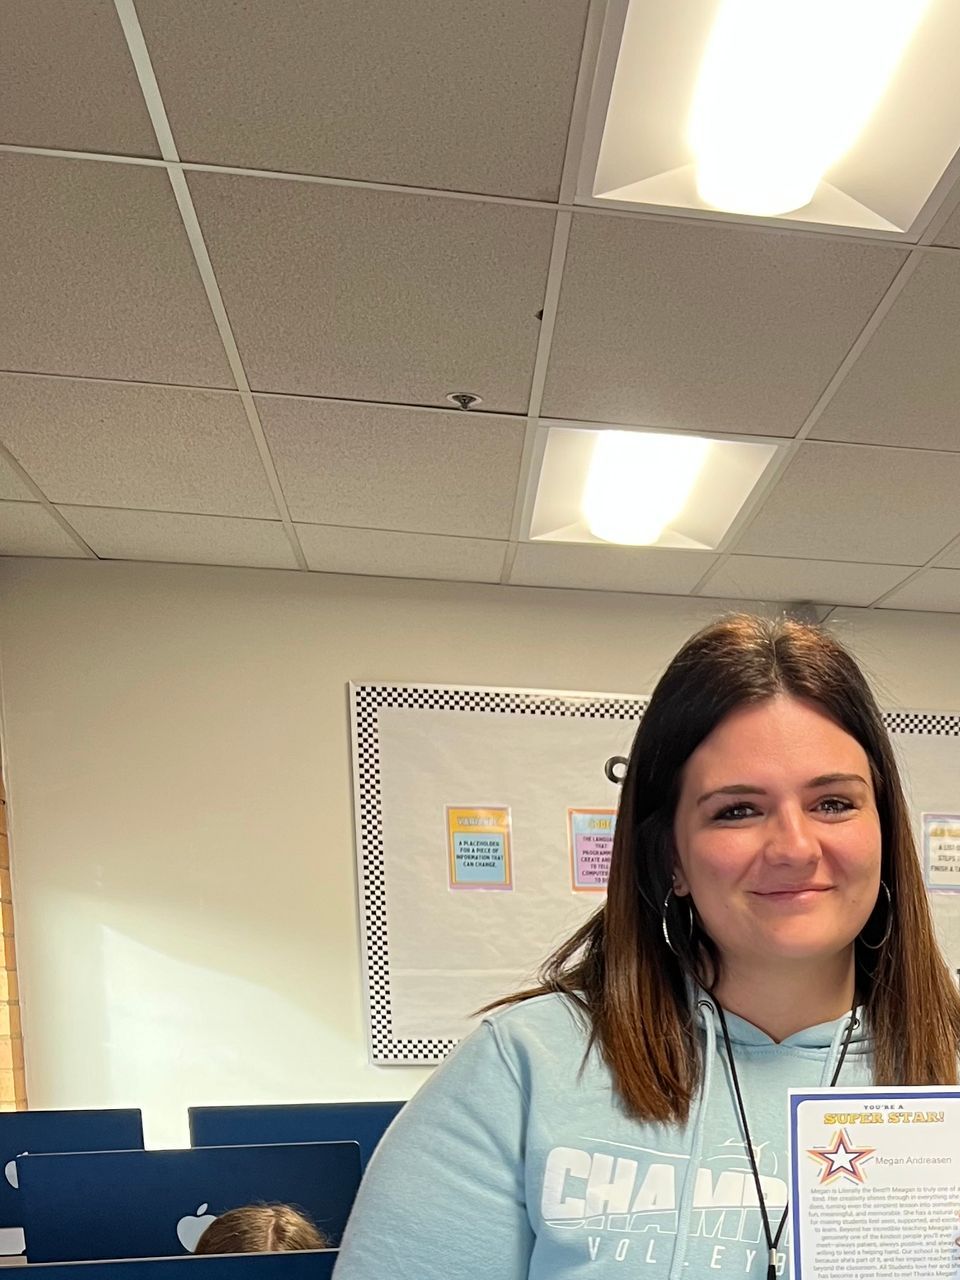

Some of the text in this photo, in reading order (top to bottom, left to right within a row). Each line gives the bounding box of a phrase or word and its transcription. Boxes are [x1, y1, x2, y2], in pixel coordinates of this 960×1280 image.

[823, 1111, 945, 1125] SUPER STAR!
[875, 1156, 952, 1167] Megan Andreasen
